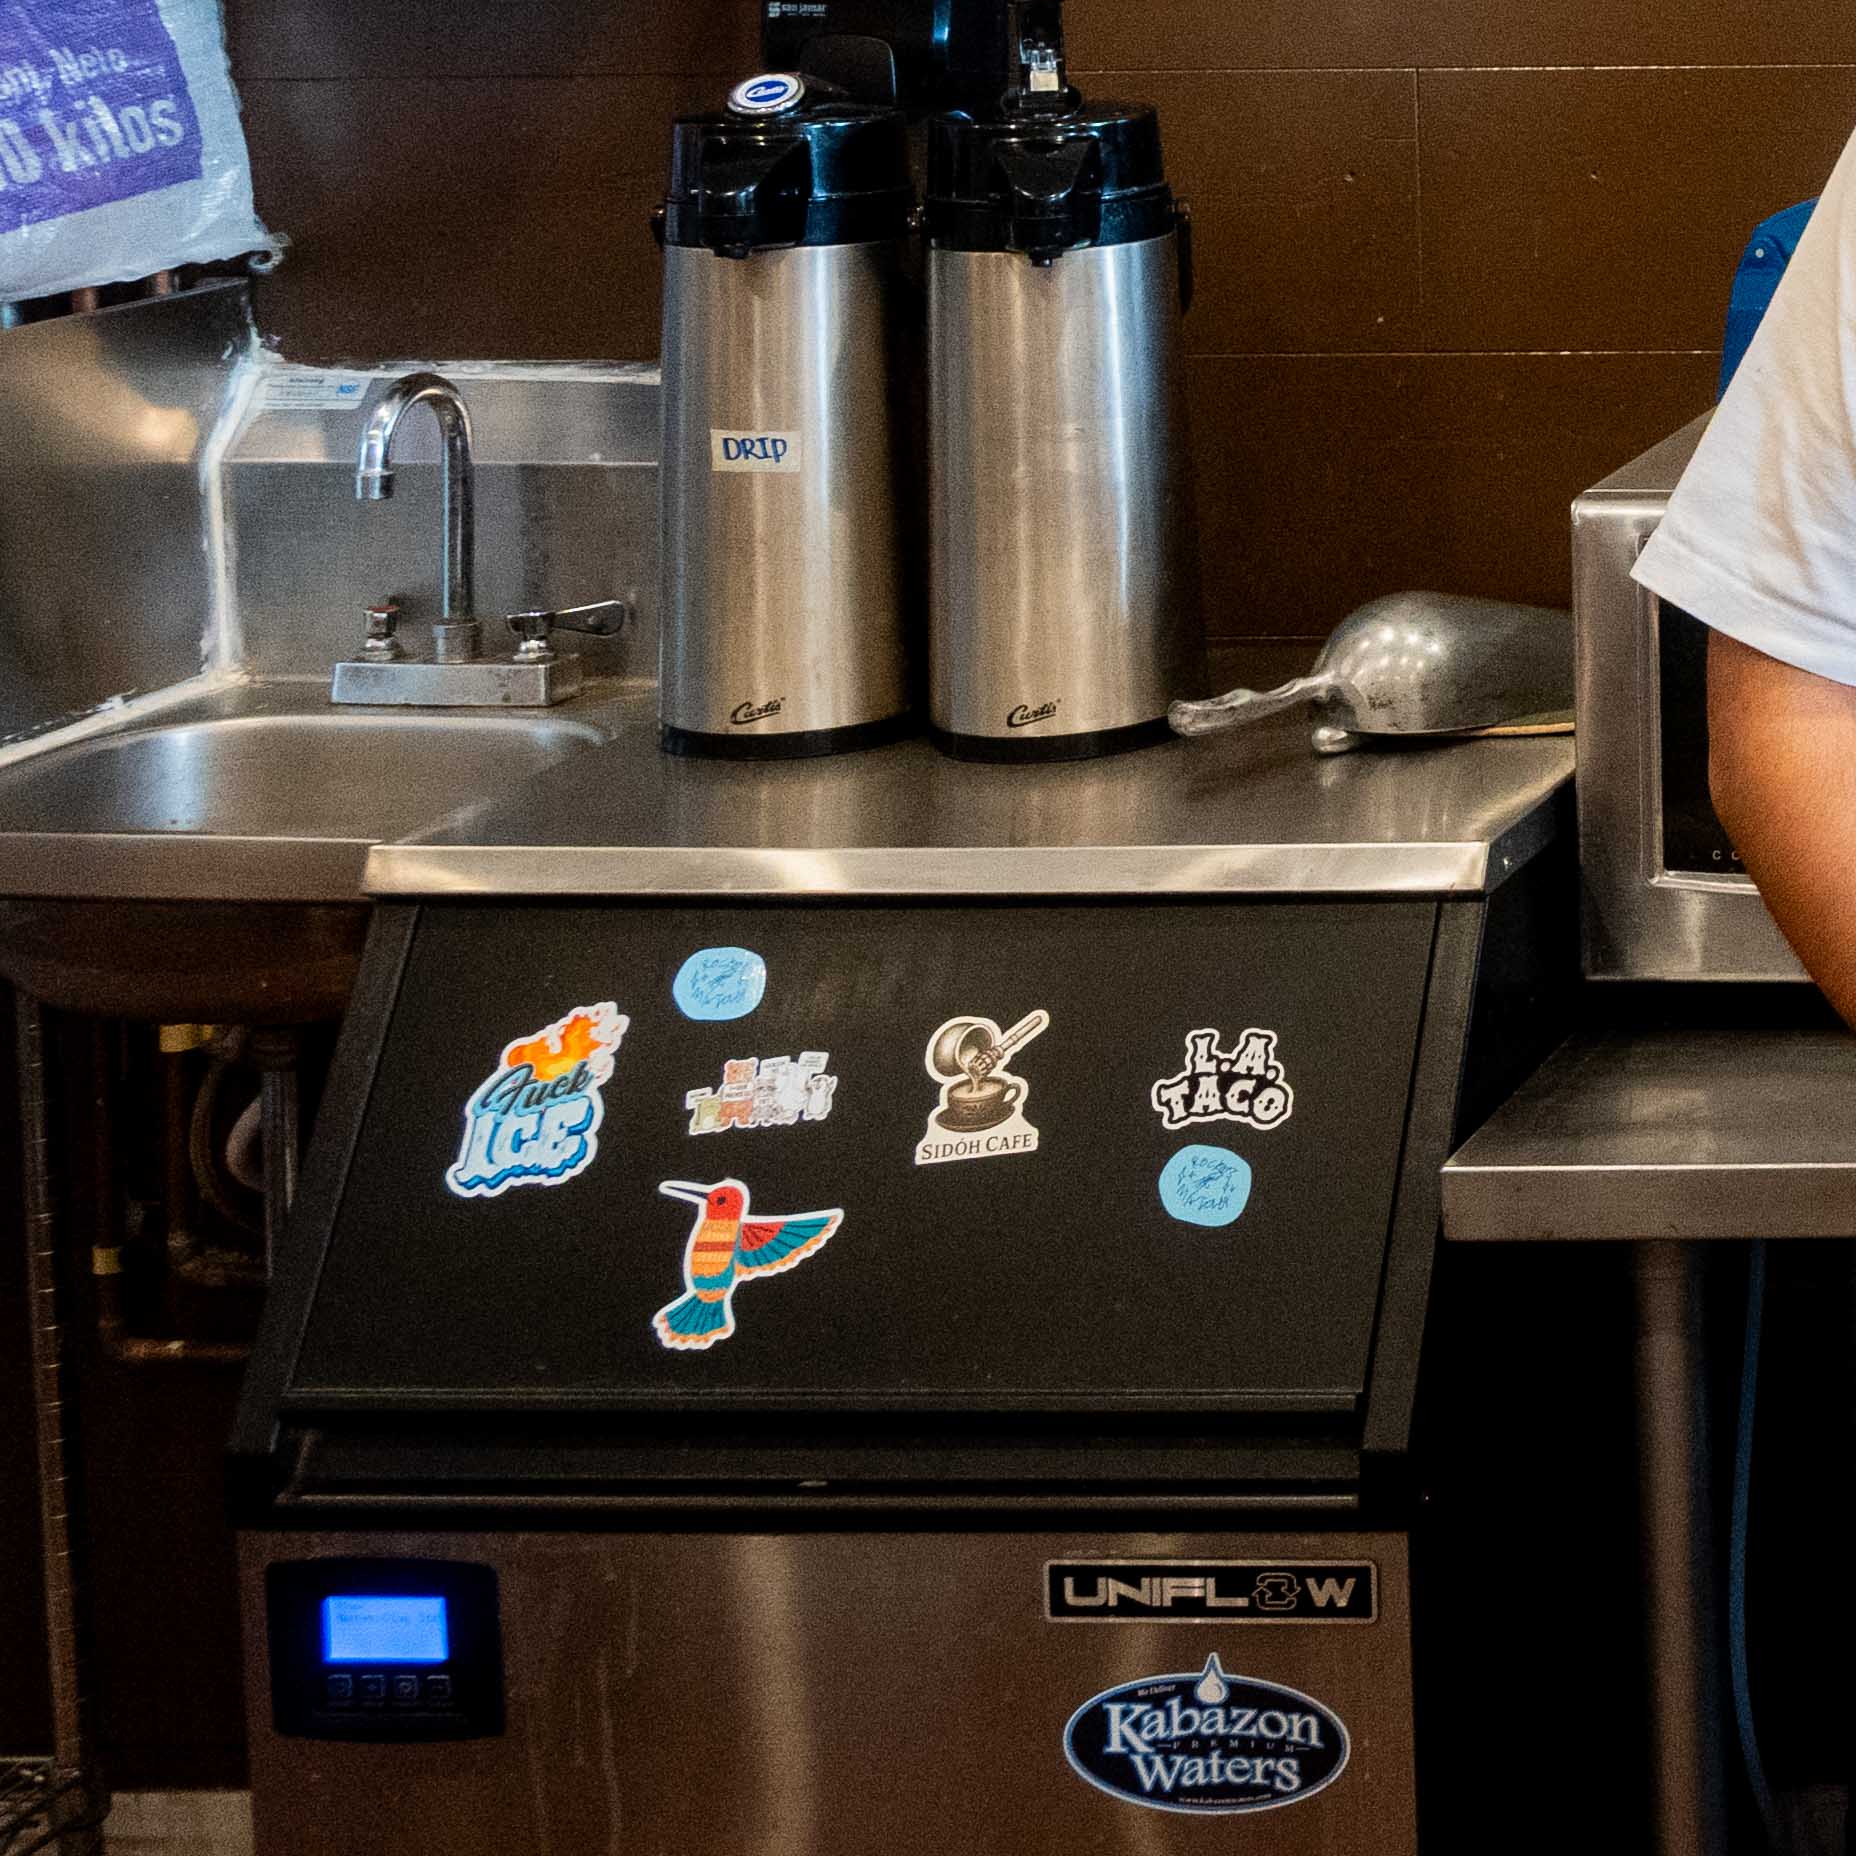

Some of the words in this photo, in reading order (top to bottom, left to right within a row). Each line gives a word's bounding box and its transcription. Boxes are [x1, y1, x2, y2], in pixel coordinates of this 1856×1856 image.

[39, 95, 185, 173] kilos
[722, 437, 788, 463] DRIP
[480, 1061, 590, 1116] Fuck
[1159, 1074, 1288, 1122] TACO
[454, 1095, 595, 1191] ICE
[921, 1138, 980, 1160] SIDÓH
[985, 1133, 1033, 1153] CAFE
[1102, 1695, 1326, 1755] Kabazon
[1129, 1748, 1300, 1792] Waters
